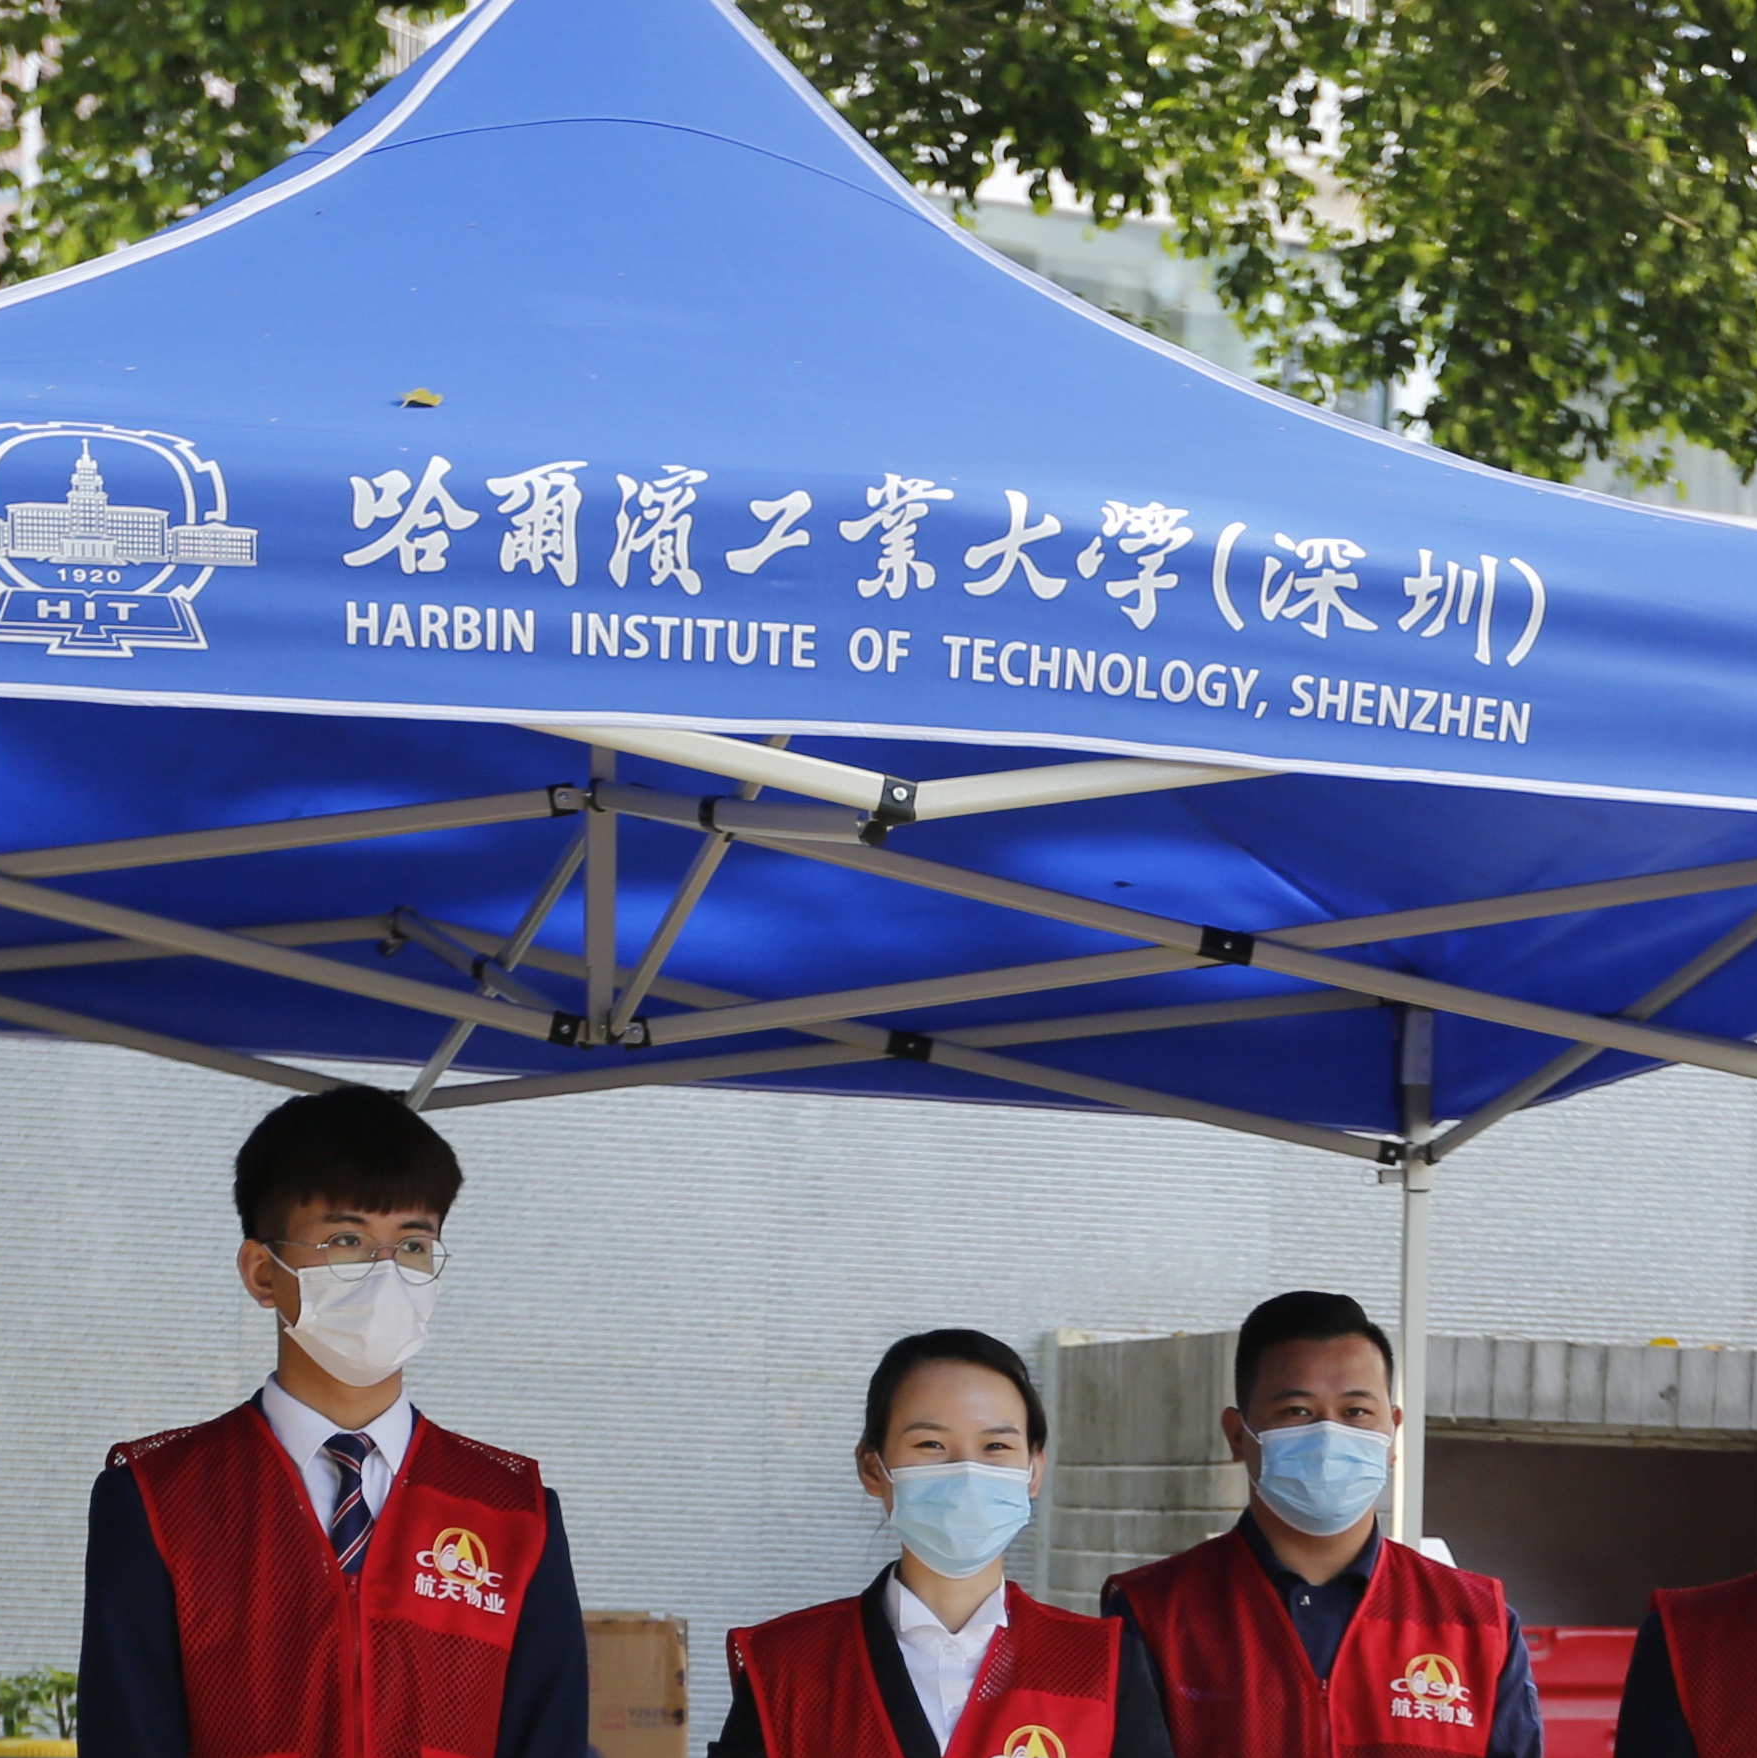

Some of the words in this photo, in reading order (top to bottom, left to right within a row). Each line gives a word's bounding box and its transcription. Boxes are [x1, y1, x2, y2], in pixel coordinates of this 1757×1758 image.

[58, 568, 121, 583] 1920
[31, 599, 138, 629] HIT
[346, 601, 534, 652] HARBIN
[572, 612, 816, 668] INSTITUTE
[849, 628, 910, 672] OF
[943, 635, 1267, 718] TECHNOLOGY,
[1290, 675, 1530, 744] SHENZHEN
[414, 1572, 506, 1615] 航天物业
[1391, 1697, 1475, 1728] 航天物业
